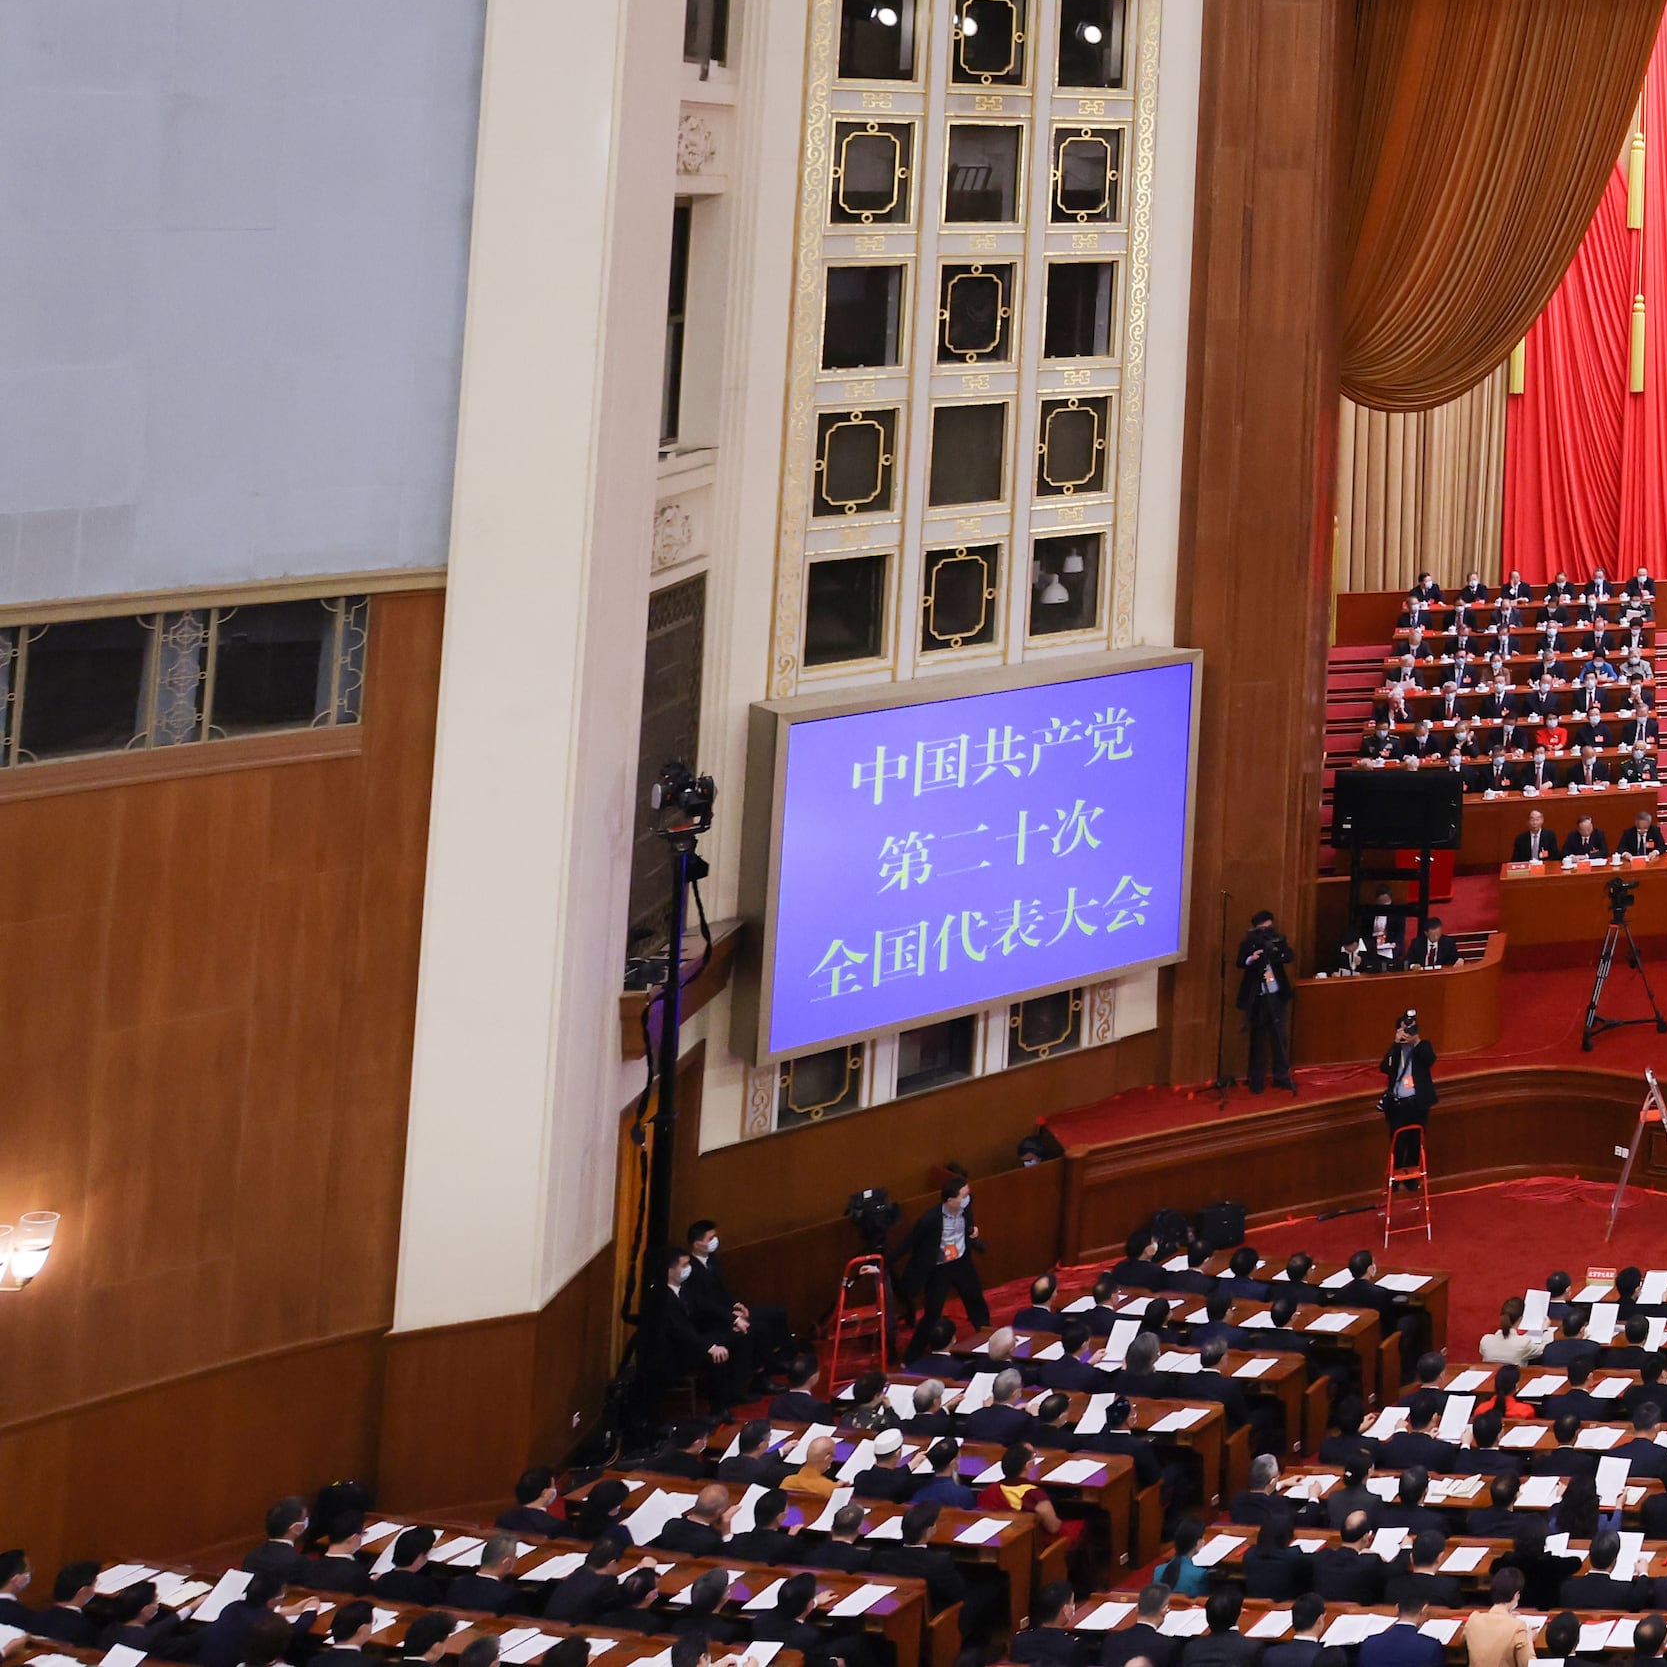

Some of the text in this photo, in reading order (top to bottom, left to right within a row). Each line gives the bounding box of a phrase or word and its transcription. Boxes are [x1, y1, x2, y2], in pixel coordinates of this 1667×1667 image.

[851, 707, 1137, 806] 中国共产党
[876, 799, 1105, 895] 第二十次
[807, 875, 1153, 1004] 全国代表大会
